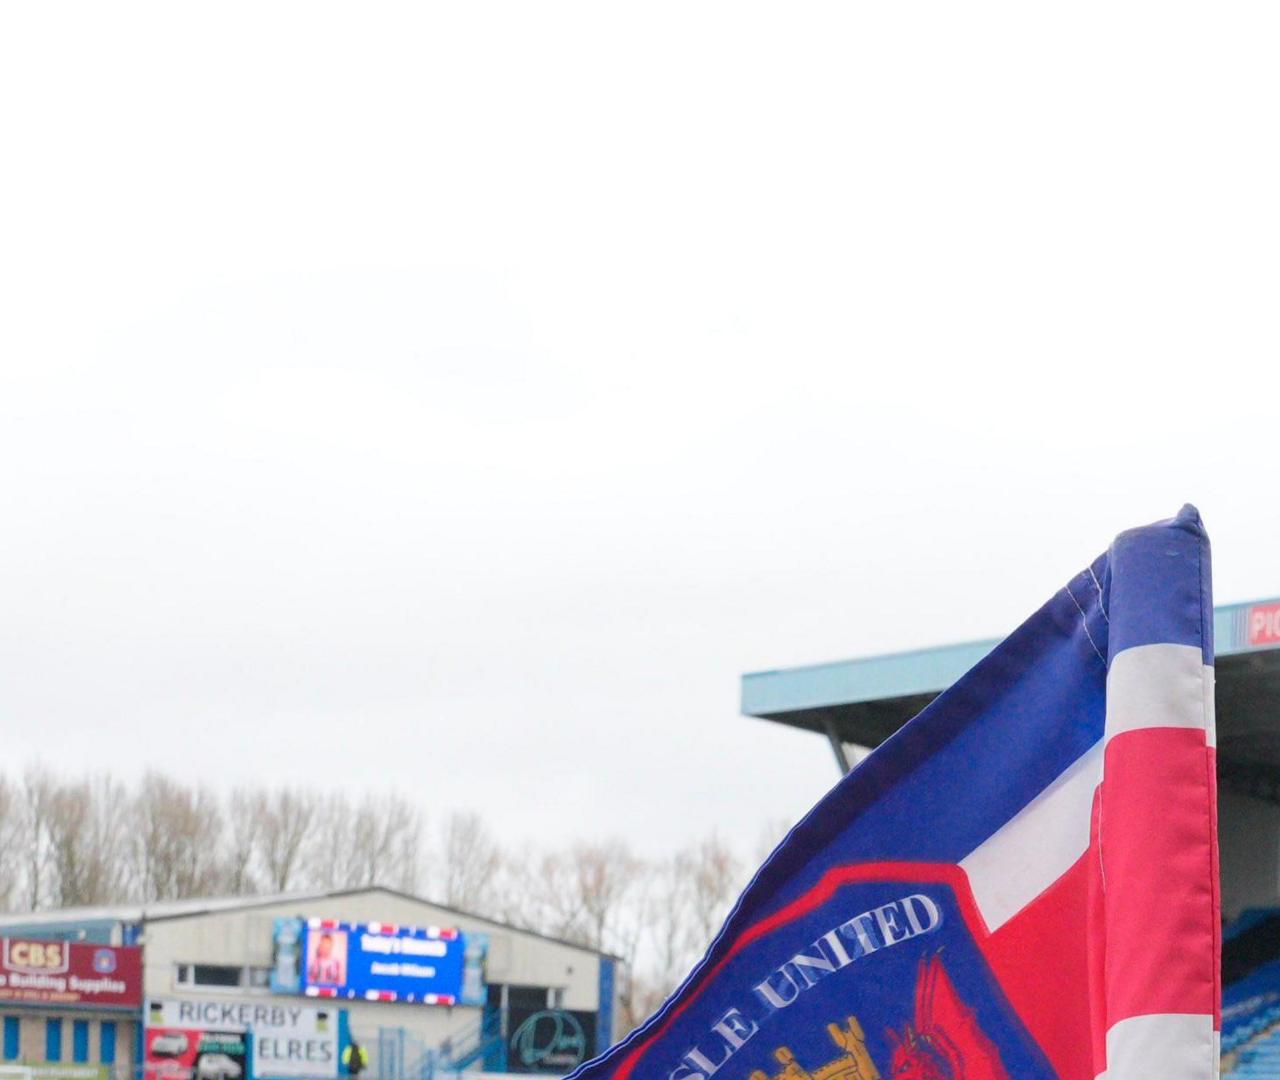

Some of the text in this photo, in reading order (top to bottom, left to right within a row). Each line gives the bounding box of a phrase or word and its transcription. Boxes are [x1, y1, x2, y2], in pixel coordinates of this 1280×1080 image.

[11, 942, 62, 967] CBS
[753, 893, 942, 1008] UNITED
[179, 1001, 302, 1027] RICKERBY
[258, 1038, 332, 1062] ELRES
